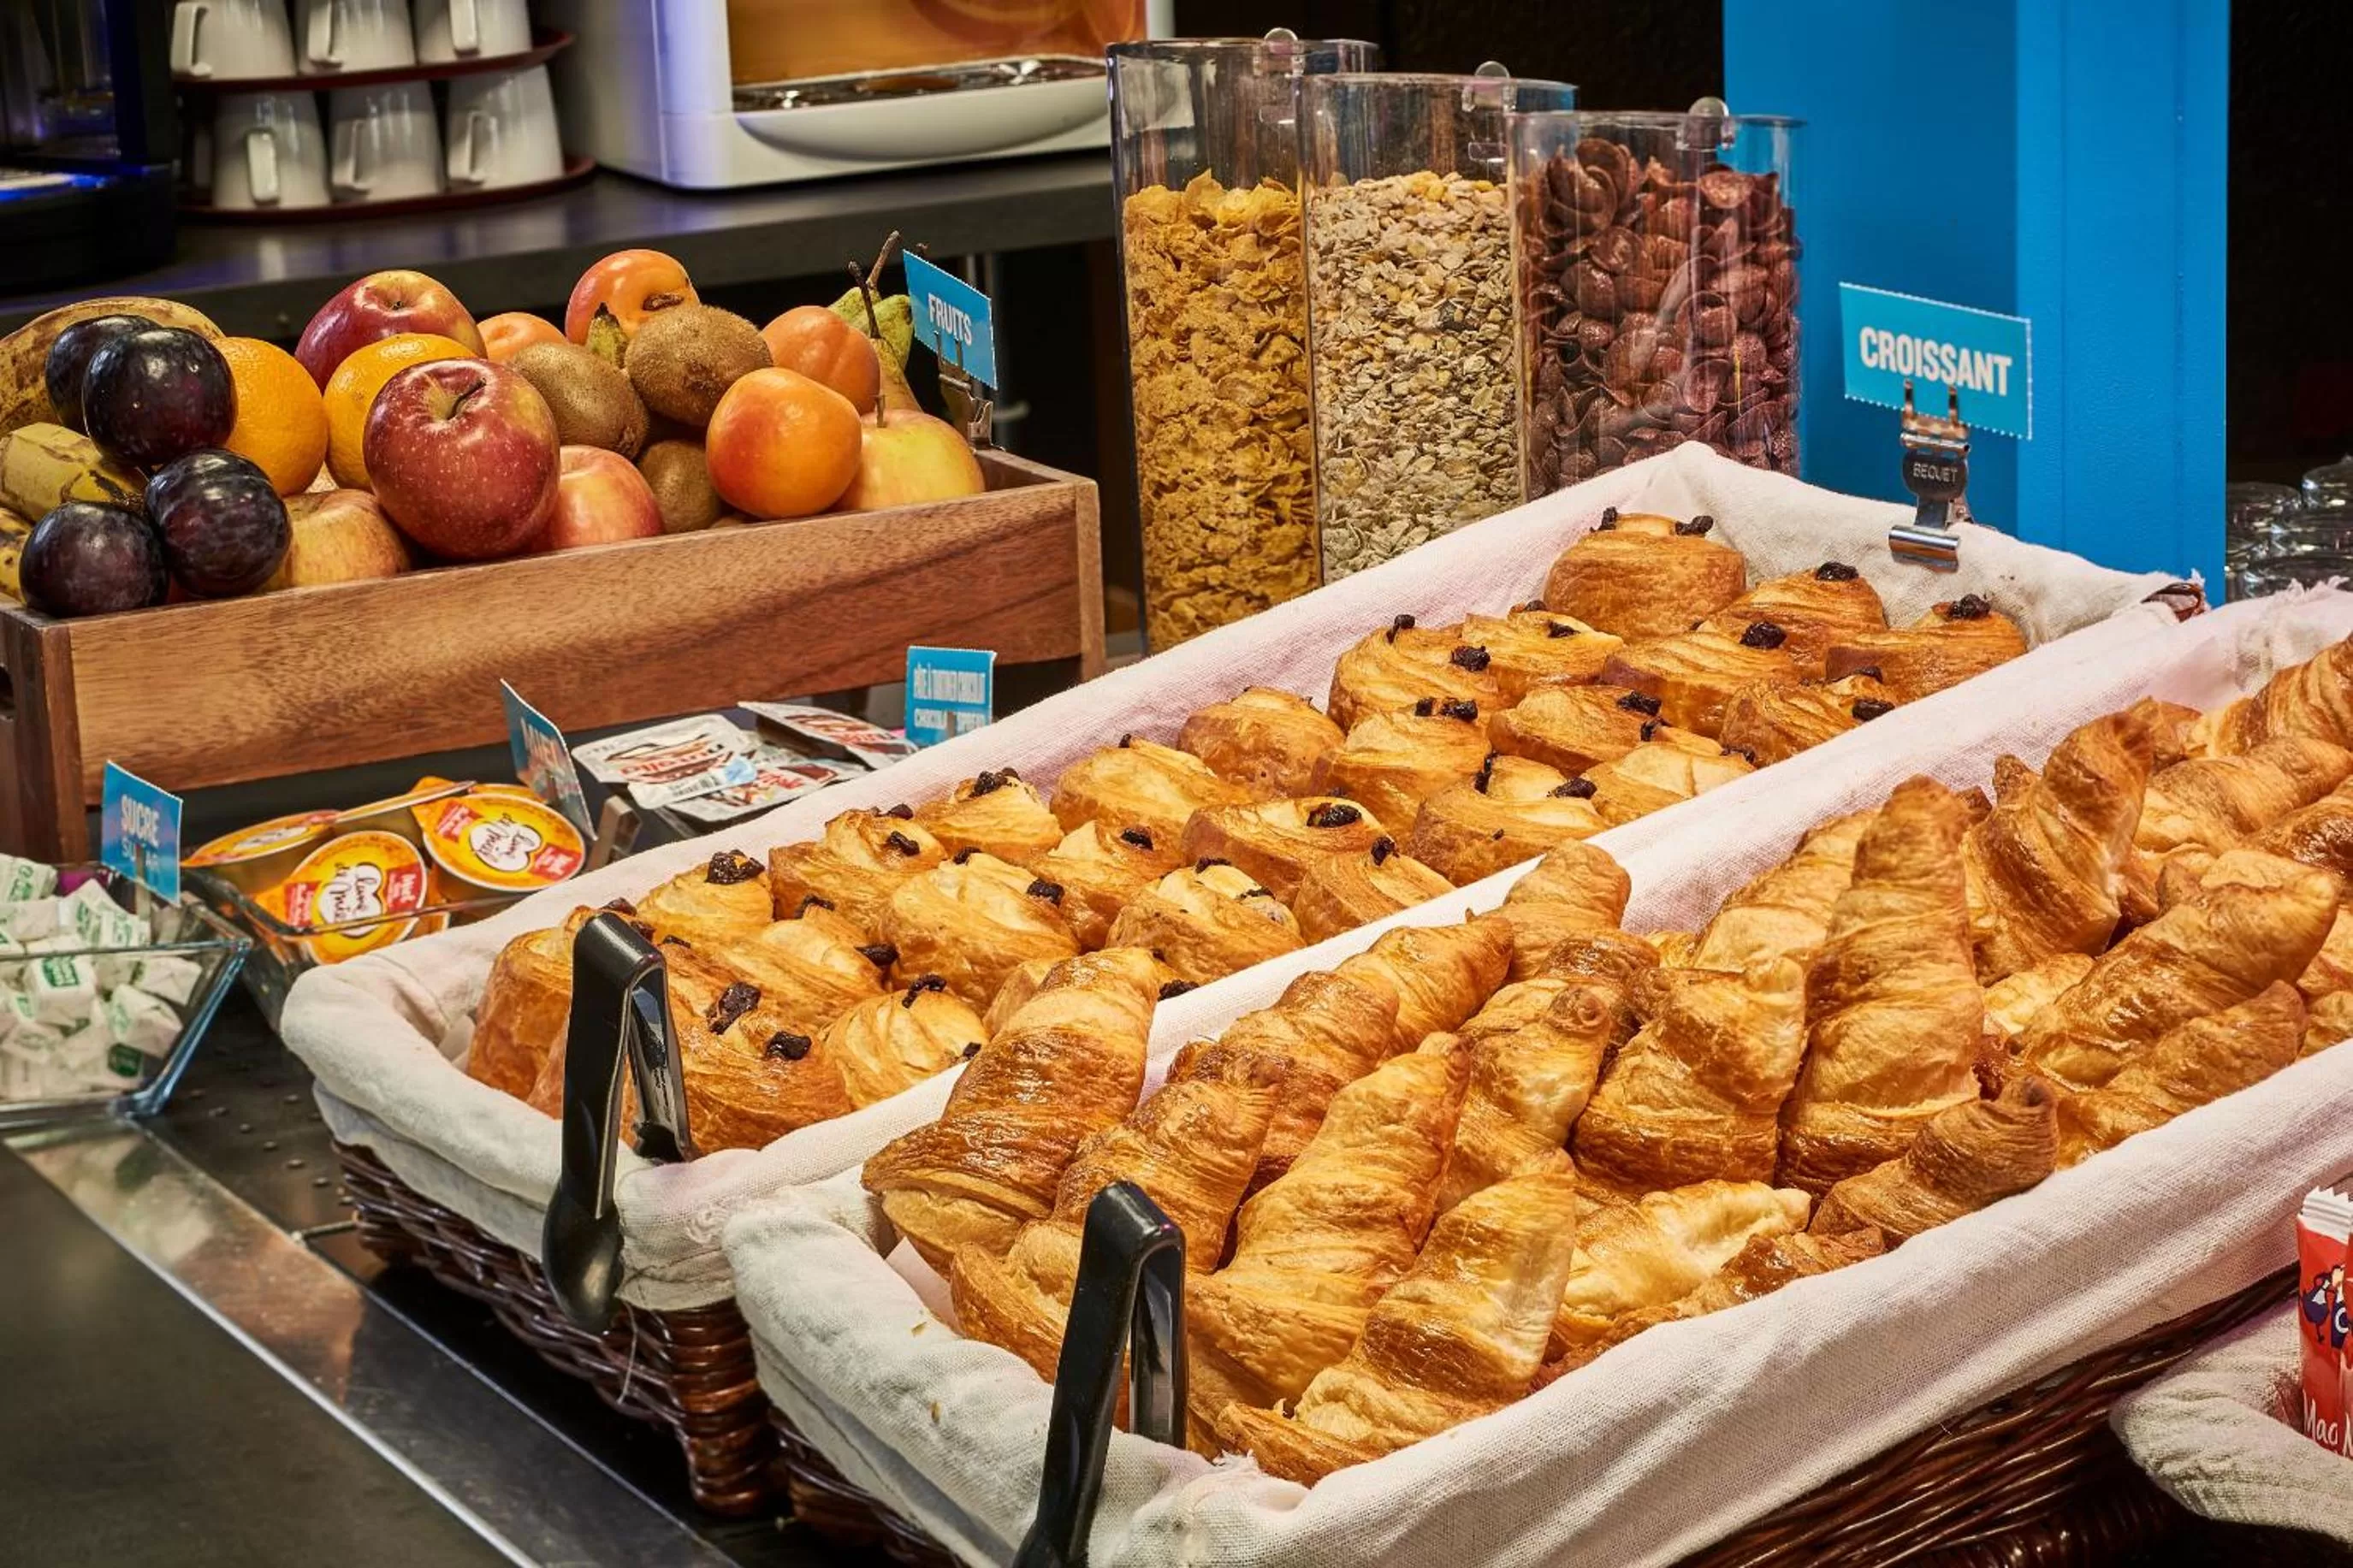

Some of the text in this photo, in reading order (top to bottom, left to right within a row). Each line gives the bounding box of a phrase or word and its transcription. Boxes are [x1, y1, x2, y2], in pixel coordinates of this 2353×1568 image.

[928, 293, 973, 346] FRUITS
[1859, 326, 2012, 396] CROISSANT
[1912, 462, 1959, 485] BEQUET
[122, 794, 160, 849] SUCRE
[122, 836, 160, 871] SUAR
